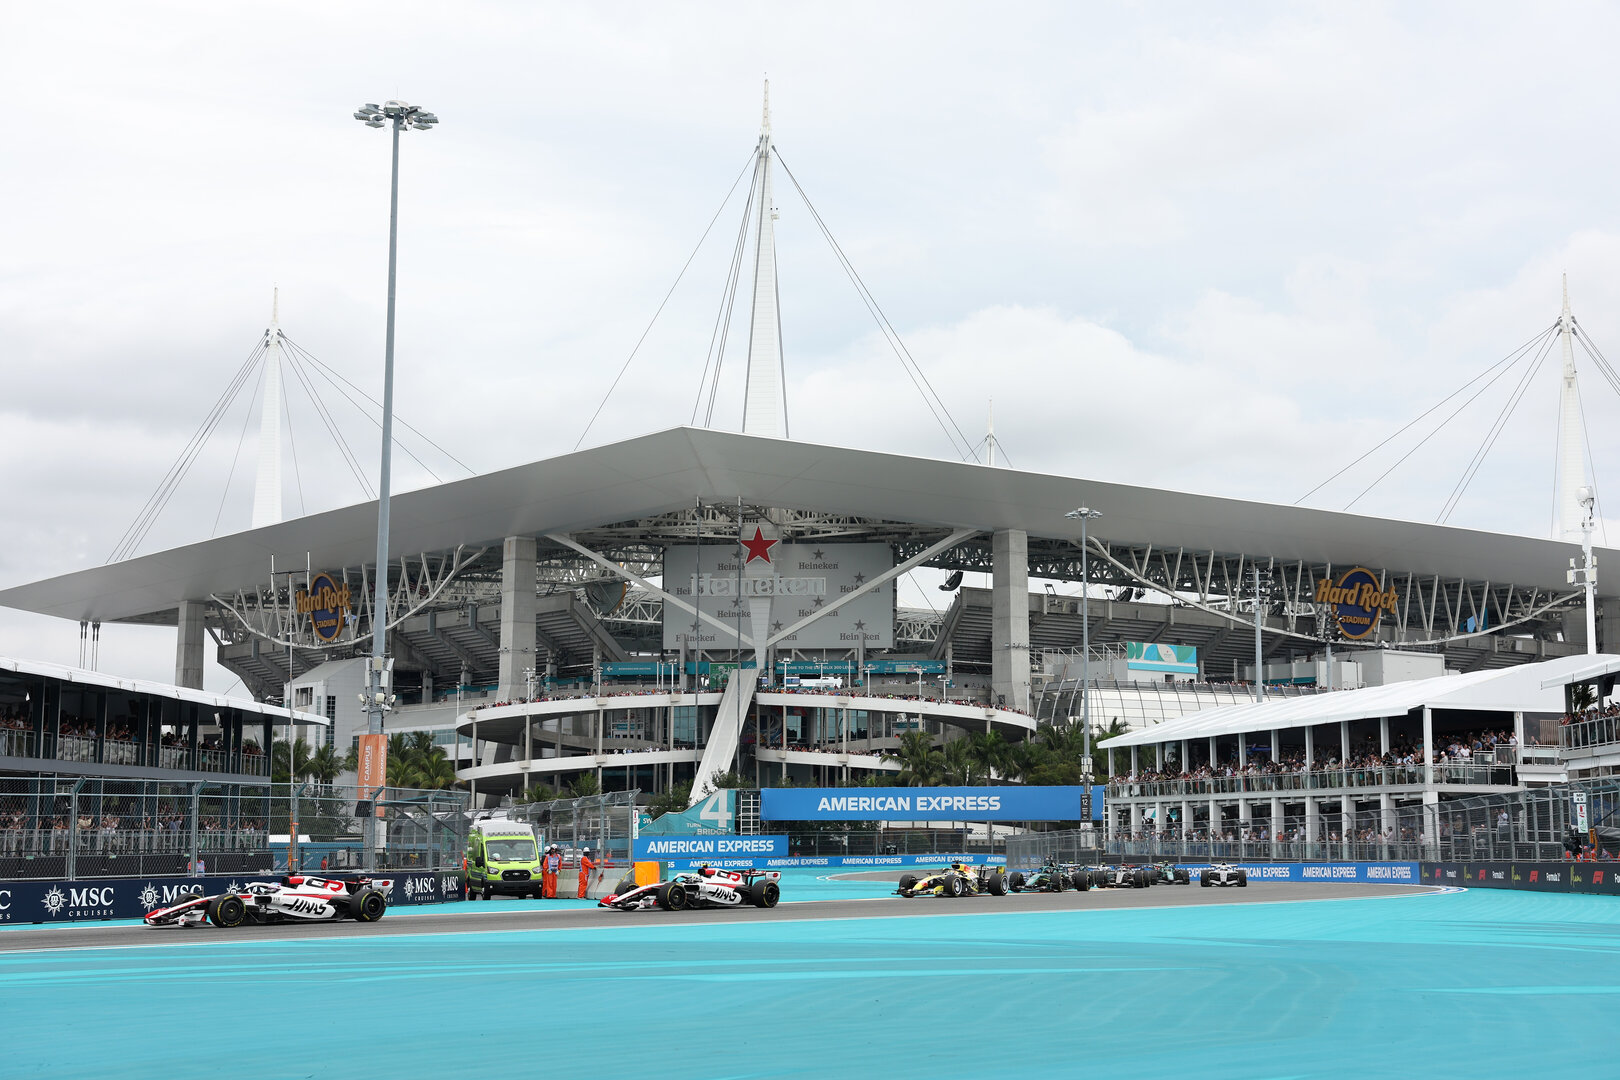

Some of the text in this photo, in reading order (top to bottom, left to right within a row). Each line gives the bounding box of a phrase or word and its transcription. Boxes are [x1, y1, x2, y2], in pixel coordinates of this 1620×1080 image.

[798, 561, 839, 570] Heineken
[691, 572, 825, 597] Heineken
[296, 583, 351, 613] Hard Rock
[1316, 579, 1398, 614] Hard Rock
[717, 609, 752, 618] Heineke
[1342, 616, 1370, 625] STADIUM
[839, 632, 881, 641] Heinken
[700, 789, 733, 828] 4
[817, 796, 1001, 811] AMERICAN EXPRESS
[647, 840, 774, 853] AMERICAN EXPRESS
[1263, 867, 1290, 877] EXPRESS
[1303, 867, 1357, 878] AMERICAN EXPRESS
[1366, 866, 1391, 878] AMERICAN
[1392, 866, 1411, 878] EXPRESS
[415, 877, 435, 894] MSC
[447, 876, 459, 892] MSC
[69, 887, 114, 907] MSC
[69, 909, 114, 917] CRUISES
